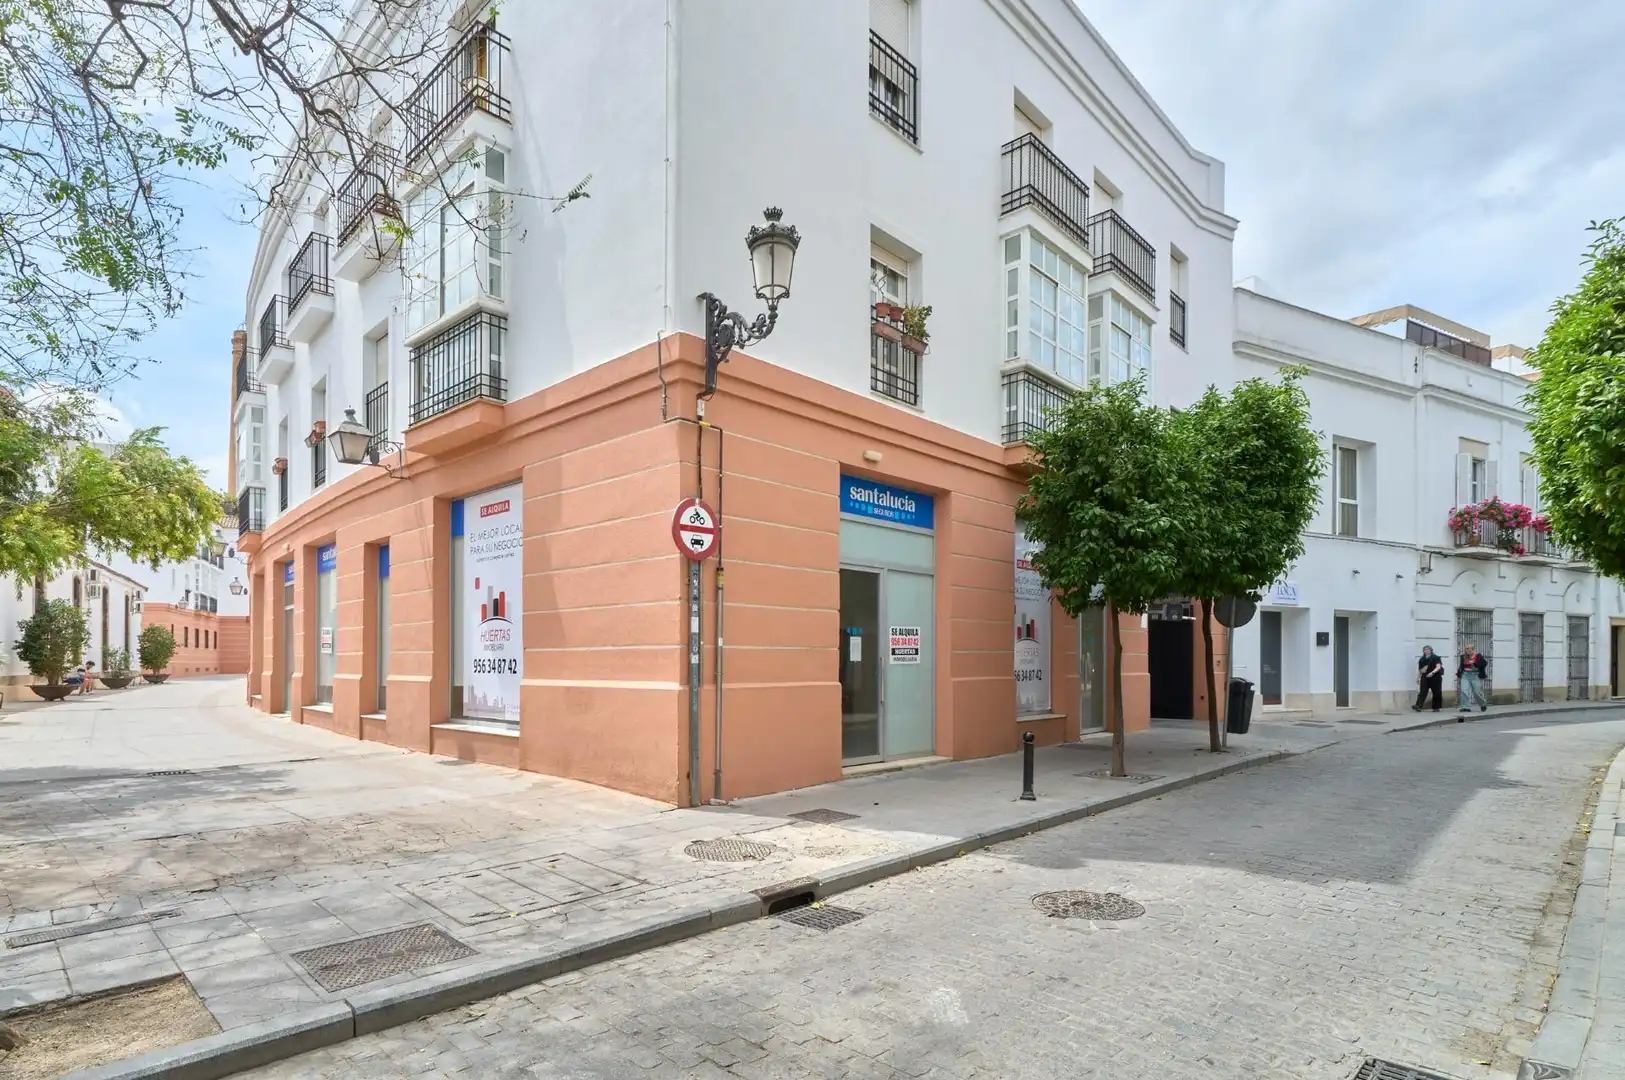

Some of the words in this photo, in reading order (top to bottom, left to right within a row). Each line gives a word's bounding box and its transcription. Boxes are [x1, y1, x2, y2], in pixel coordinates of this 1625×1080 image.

[850, 486, 916, 513] santalucía
[488, 502, 510, 515] ALQUILA
[477, 527, 499, 541] MEJOR
[500, 523, 524, 536] LOCAL
[469, 545, 485, 556] PARA
[480, 628, 511, 643] HUERTAS
[891, 627, 898, 636] SE
[898, 628, 919, 637] ALQUILA
[473, 658, 486, 674] 956
[487, 658, 496, 674] 34
[497, 658, 506, 674] 87
[507, 658, 518, 675] 42
